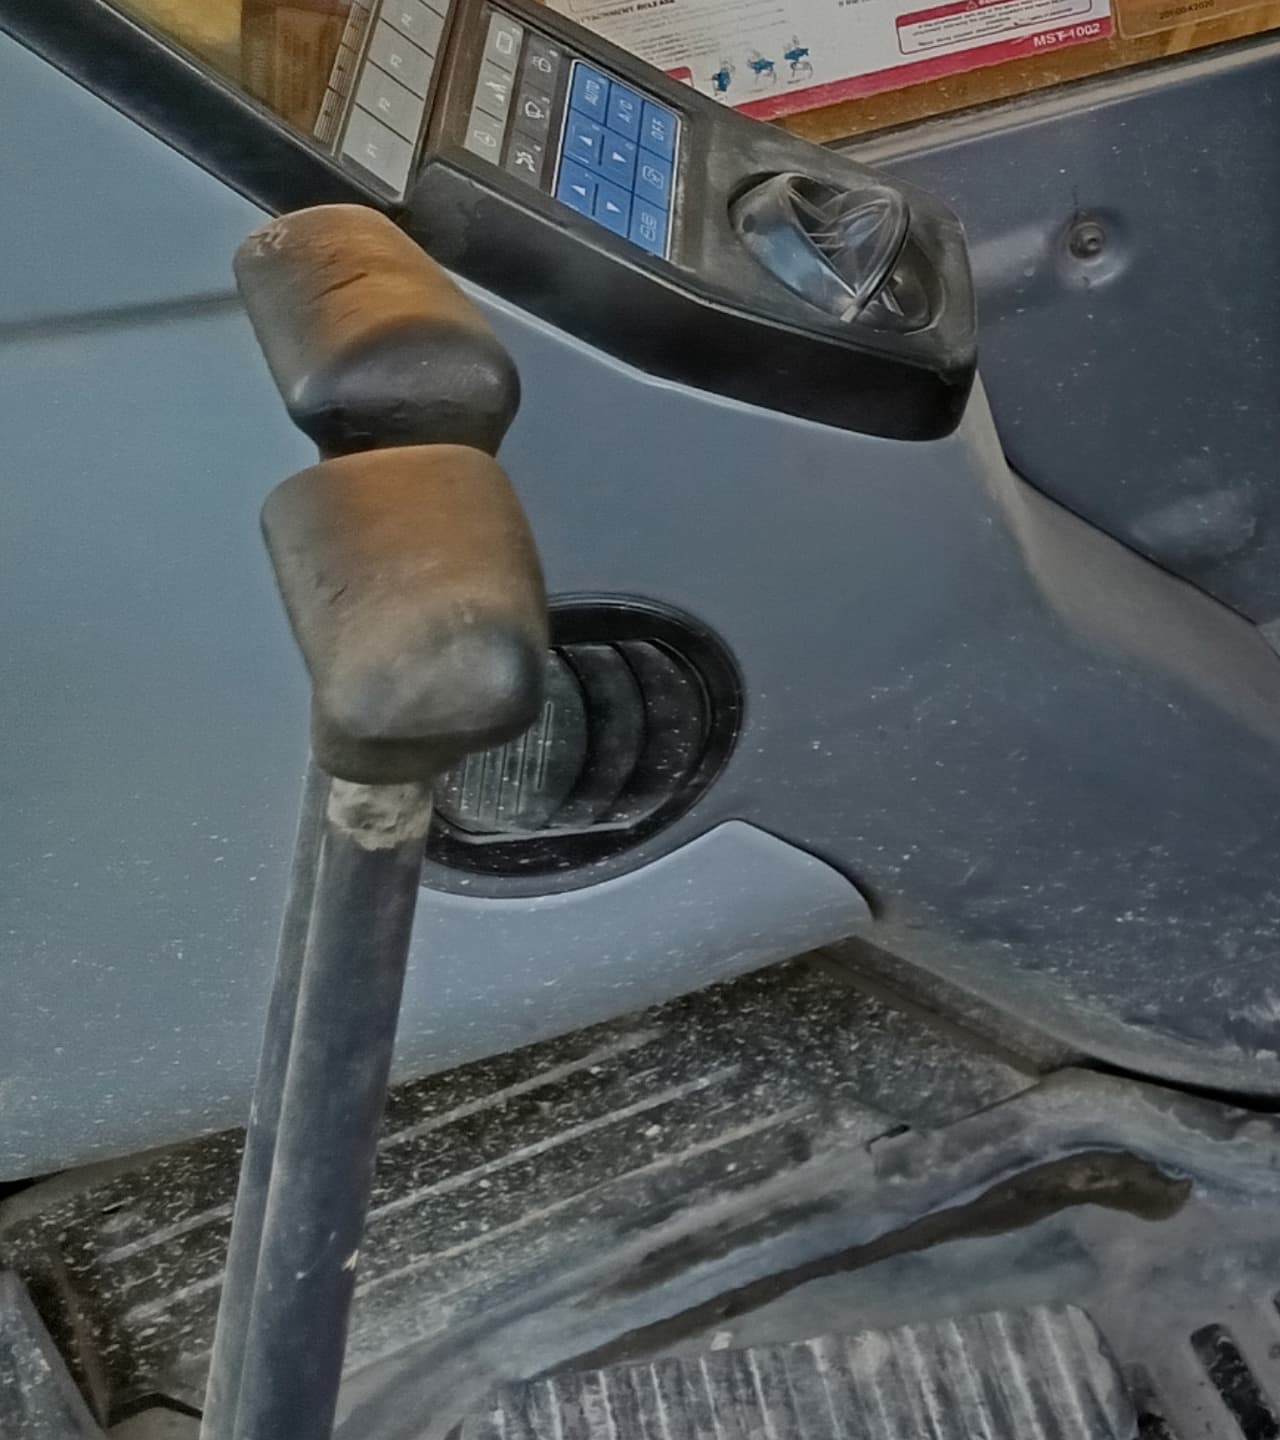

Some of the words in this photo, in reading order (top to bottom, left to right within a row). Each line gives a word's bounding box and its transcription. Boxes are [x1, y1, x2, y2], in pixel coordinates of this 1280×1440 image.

[1033, 23, 1101, 47] MST-1002
[584, 79, 600, 106] AUTO
[650, 117, 665, 141] OFF
